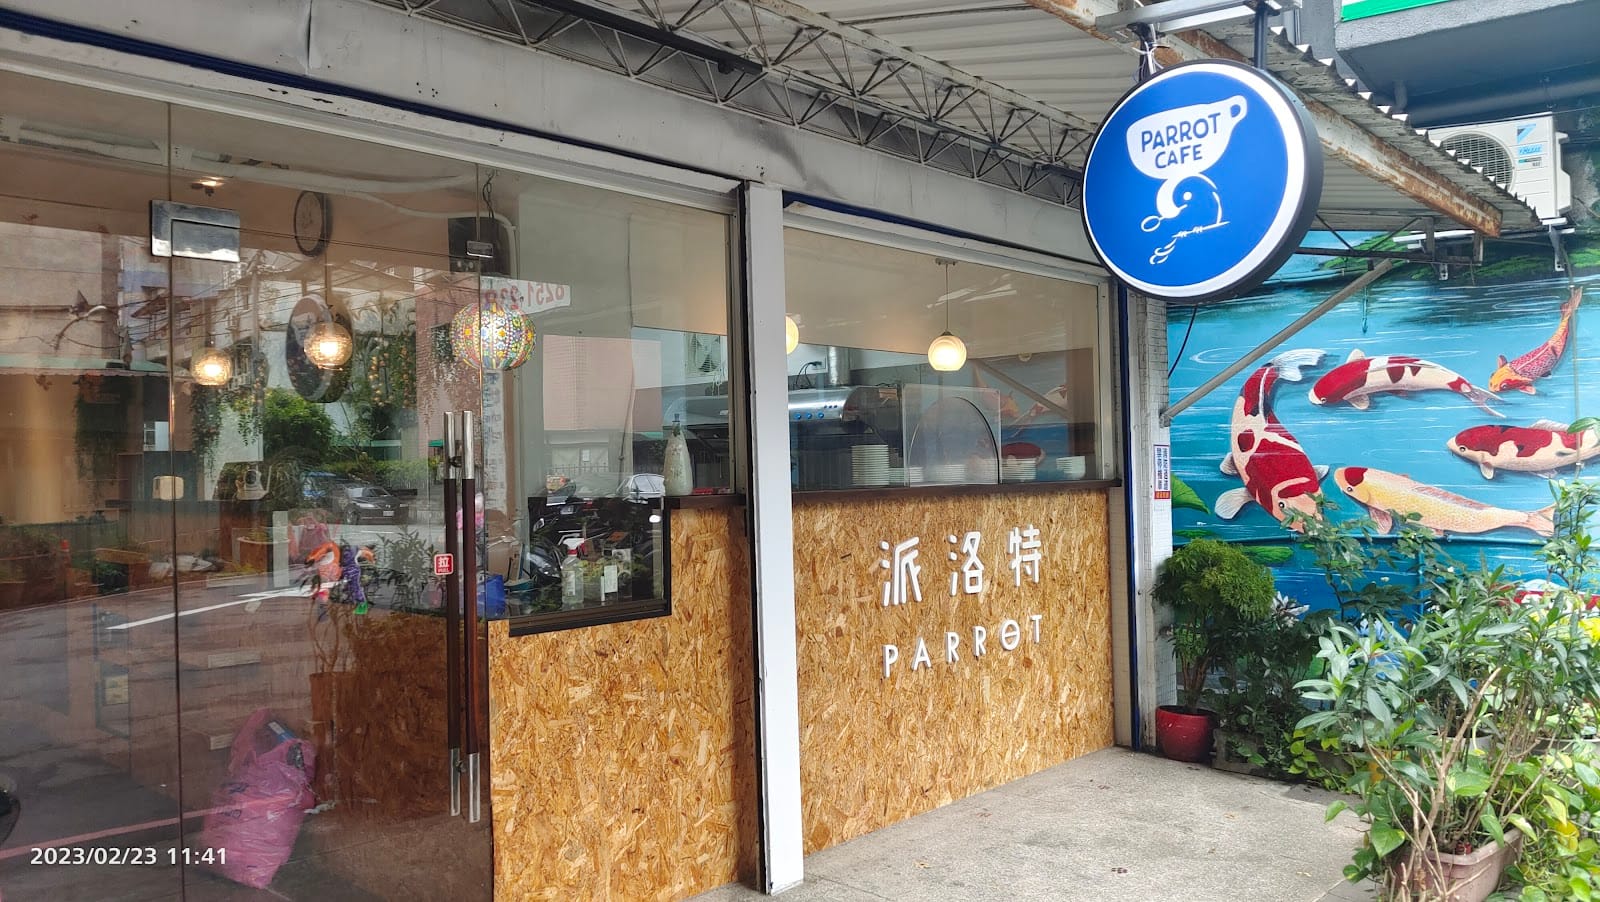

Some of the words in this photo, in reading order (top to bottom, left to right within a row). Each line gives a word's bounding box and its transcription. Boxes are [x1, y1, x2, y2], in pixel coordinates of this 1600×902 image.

[1141, 112, 1221, 153] PARROT
[1155, 144, 1202, 169] CAFE
[879, 524, 1042, 608] 派洛特
[882, 614, 1043, 679] PARROT
